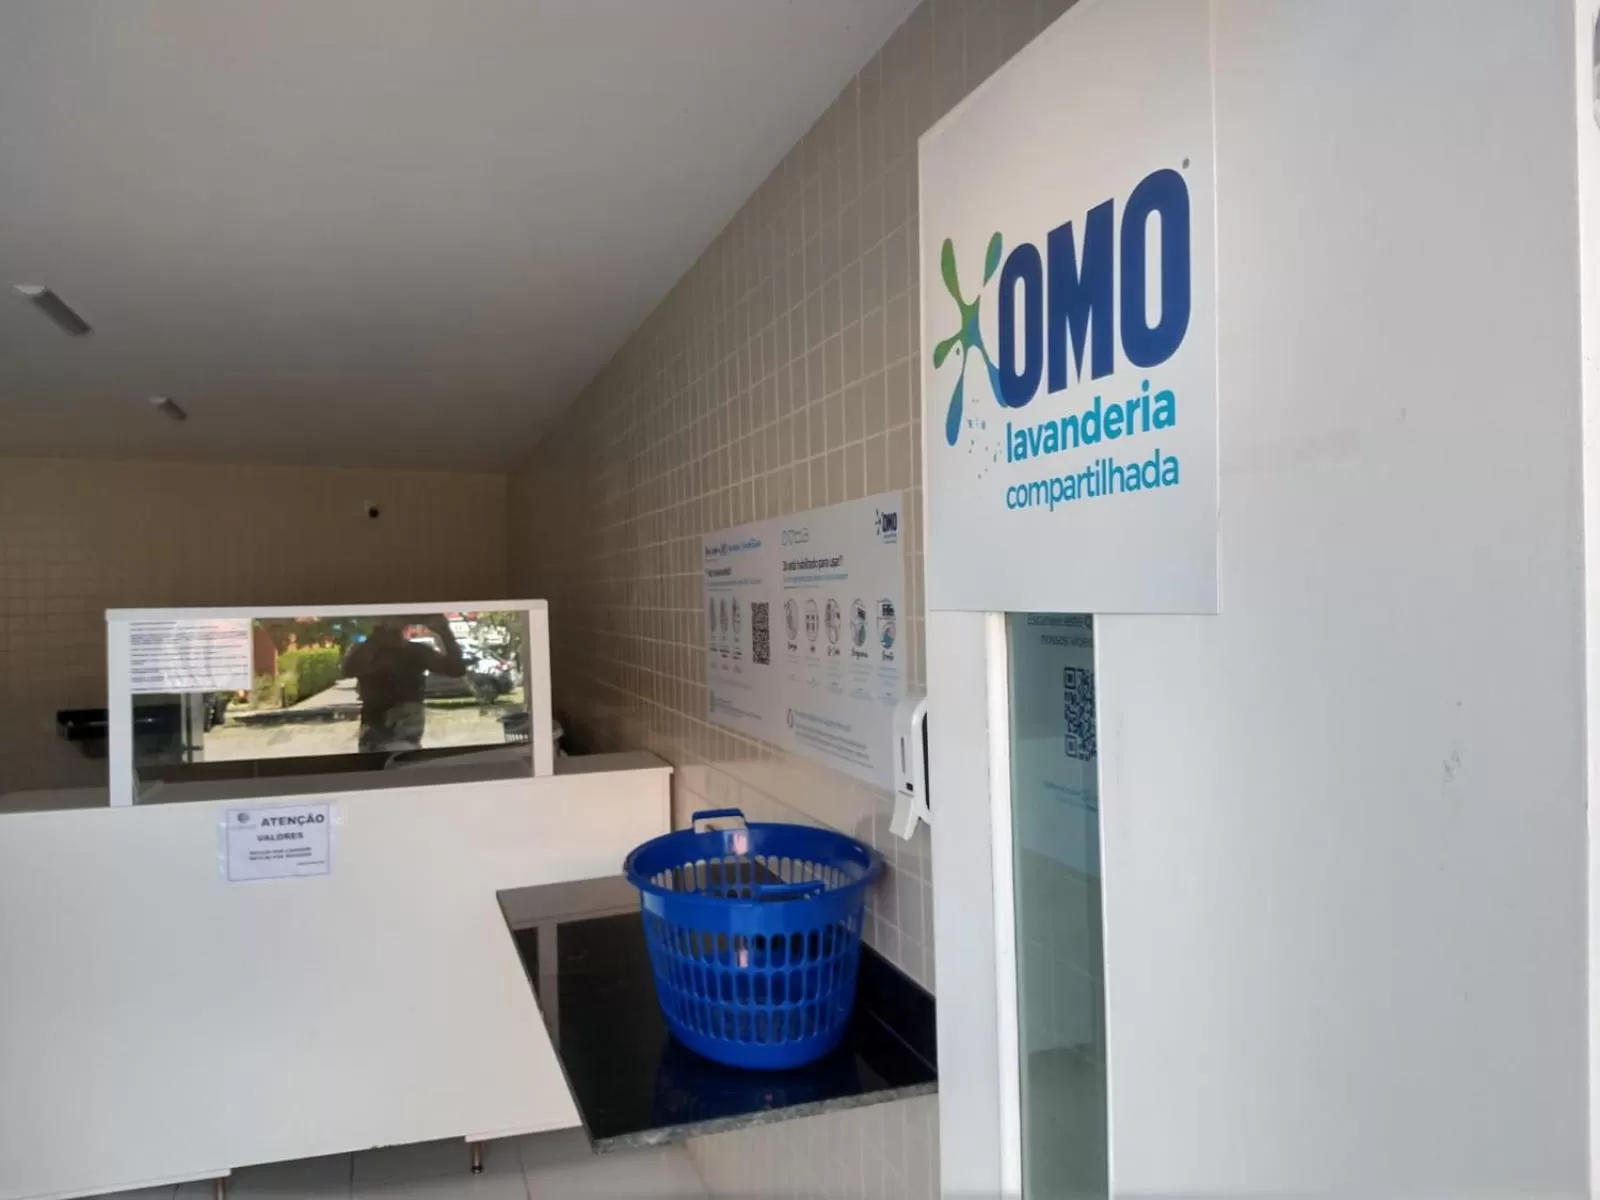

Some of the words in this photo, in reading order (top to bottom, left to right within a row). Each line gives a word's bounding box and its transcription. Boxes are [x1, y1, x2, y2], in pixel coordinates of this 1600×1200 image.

[998, 168, 1191, 409] OMO
[1006, 379, 1176, 463] lavanderia
[1006, 449, 1179, 512] compartilhada
[882, 511, 898, 532] OMO
[256, 831, 304, 842] VALORES
[261, 812, 325, 827] ATENÇÃO
